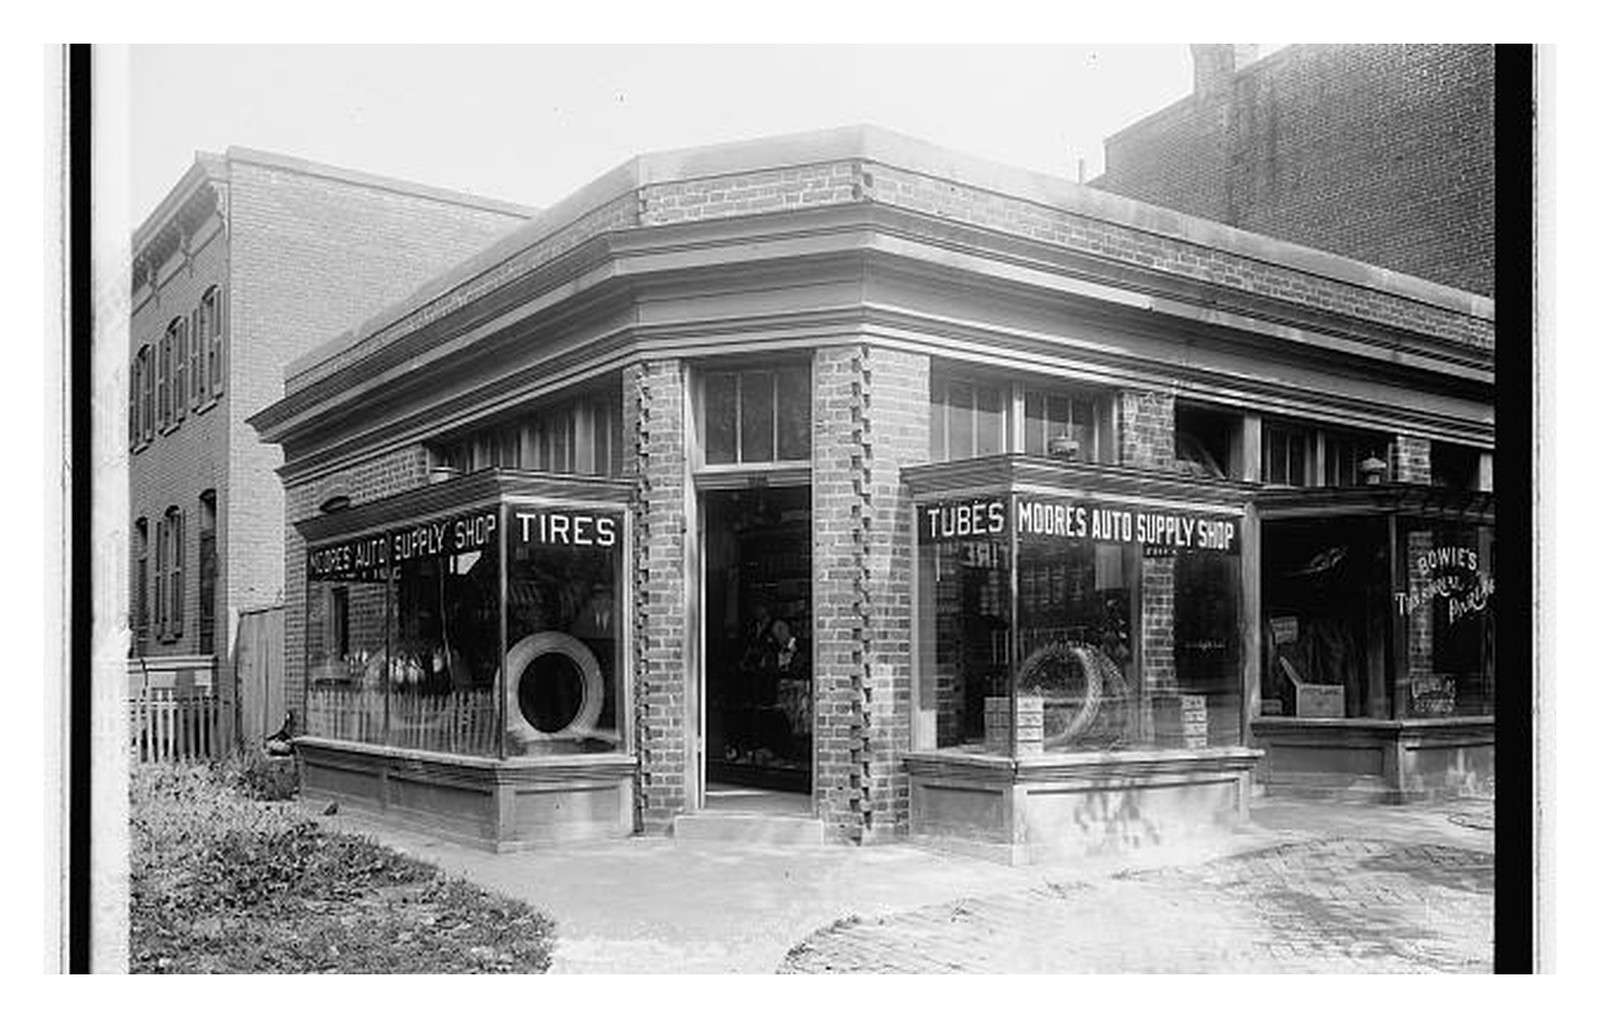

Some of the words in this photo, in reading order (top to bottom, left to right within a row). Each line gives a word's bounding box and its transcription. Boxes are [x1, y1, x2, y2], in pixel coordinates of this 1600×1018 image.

[516, 513, 615, 546] TIRES
[928, 502, 1004, 538] TUBES
[1018, 502, 1087, 538] MOORES
[1092, 509, 1132, 542] AUTO
[1137, 514, 1195, 547] SUPPLY
[1198, 519, 1234, 550] SHOP
[355, 538, 386, 569] AUTO
[395, 522, 446, 561] SUPPLY
[455, 514, 496, 549] SHOP
